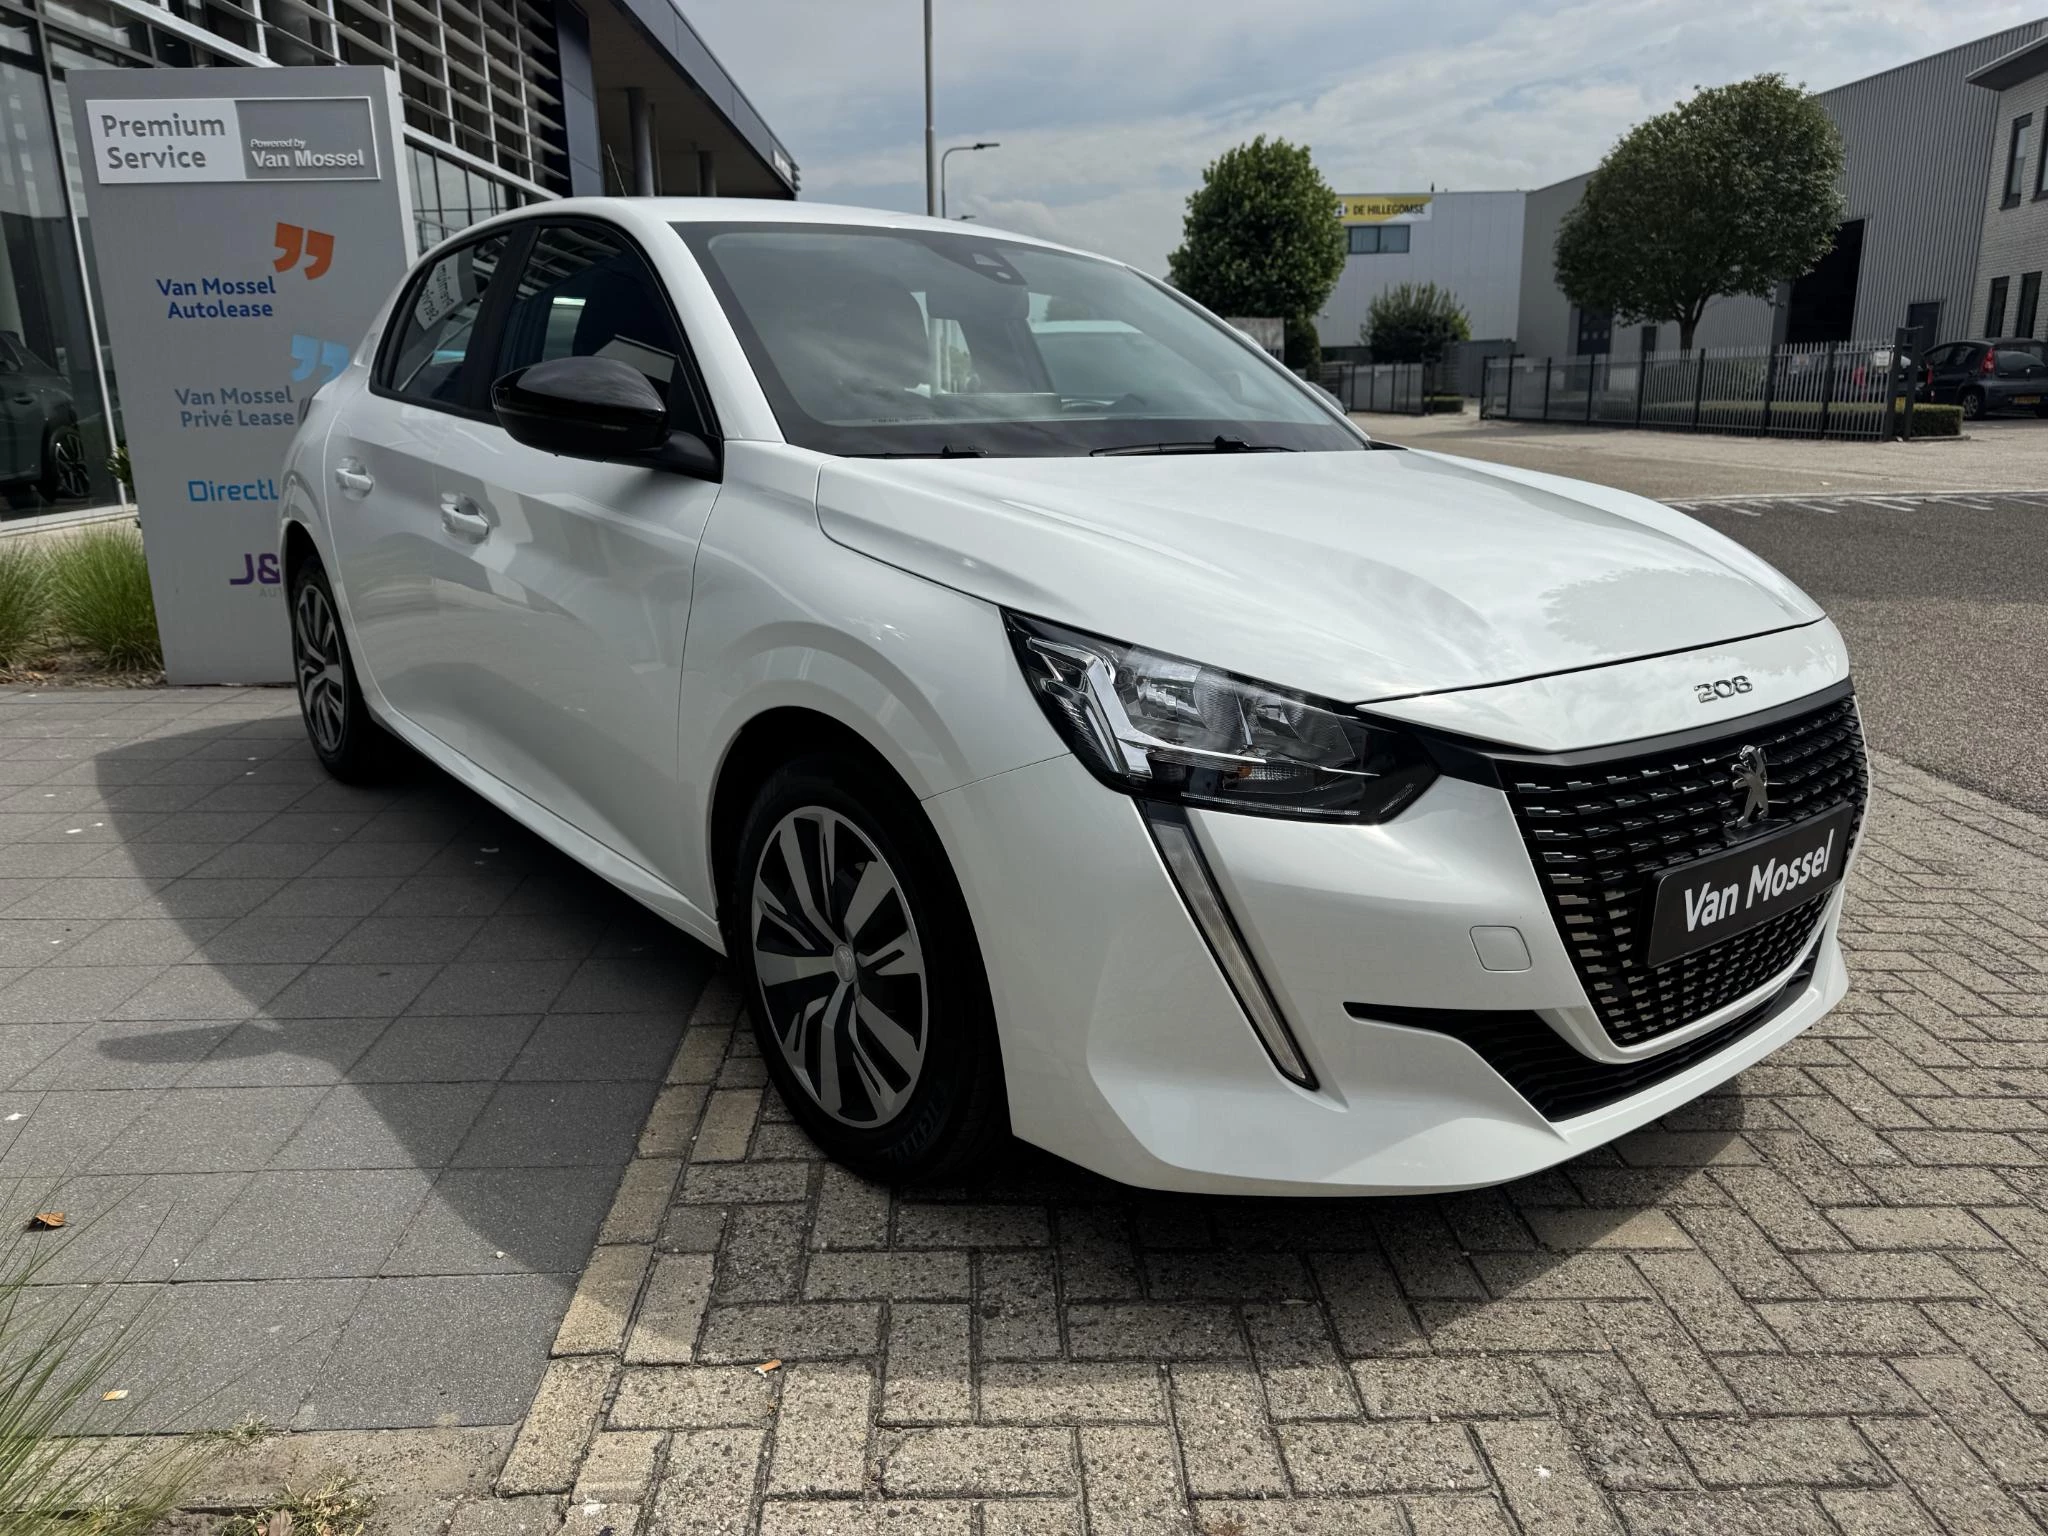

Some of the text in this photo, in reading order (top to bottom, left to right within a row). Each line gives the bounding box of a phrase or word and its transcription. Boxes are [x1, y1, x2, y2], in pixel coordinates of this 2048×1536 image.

[101, 113, 225, 137] Premium
[250, 138, 306, 149] Powered by
[107, 144, 207, 169] Service
[251, 148, 365, 167] Van Mossel
[1353, 205, 1366, 215] DE
[156, 275, 276, 297] Van Mossel
[167, 301, 273, 319] Autolease
[174, 384, 294, 406] Van Mossel
[180, 408, 294, 428] Privé Lease
[1693, 674, 1753, 703] 208
[1684, 827, 1835, 932] Van Mossel
